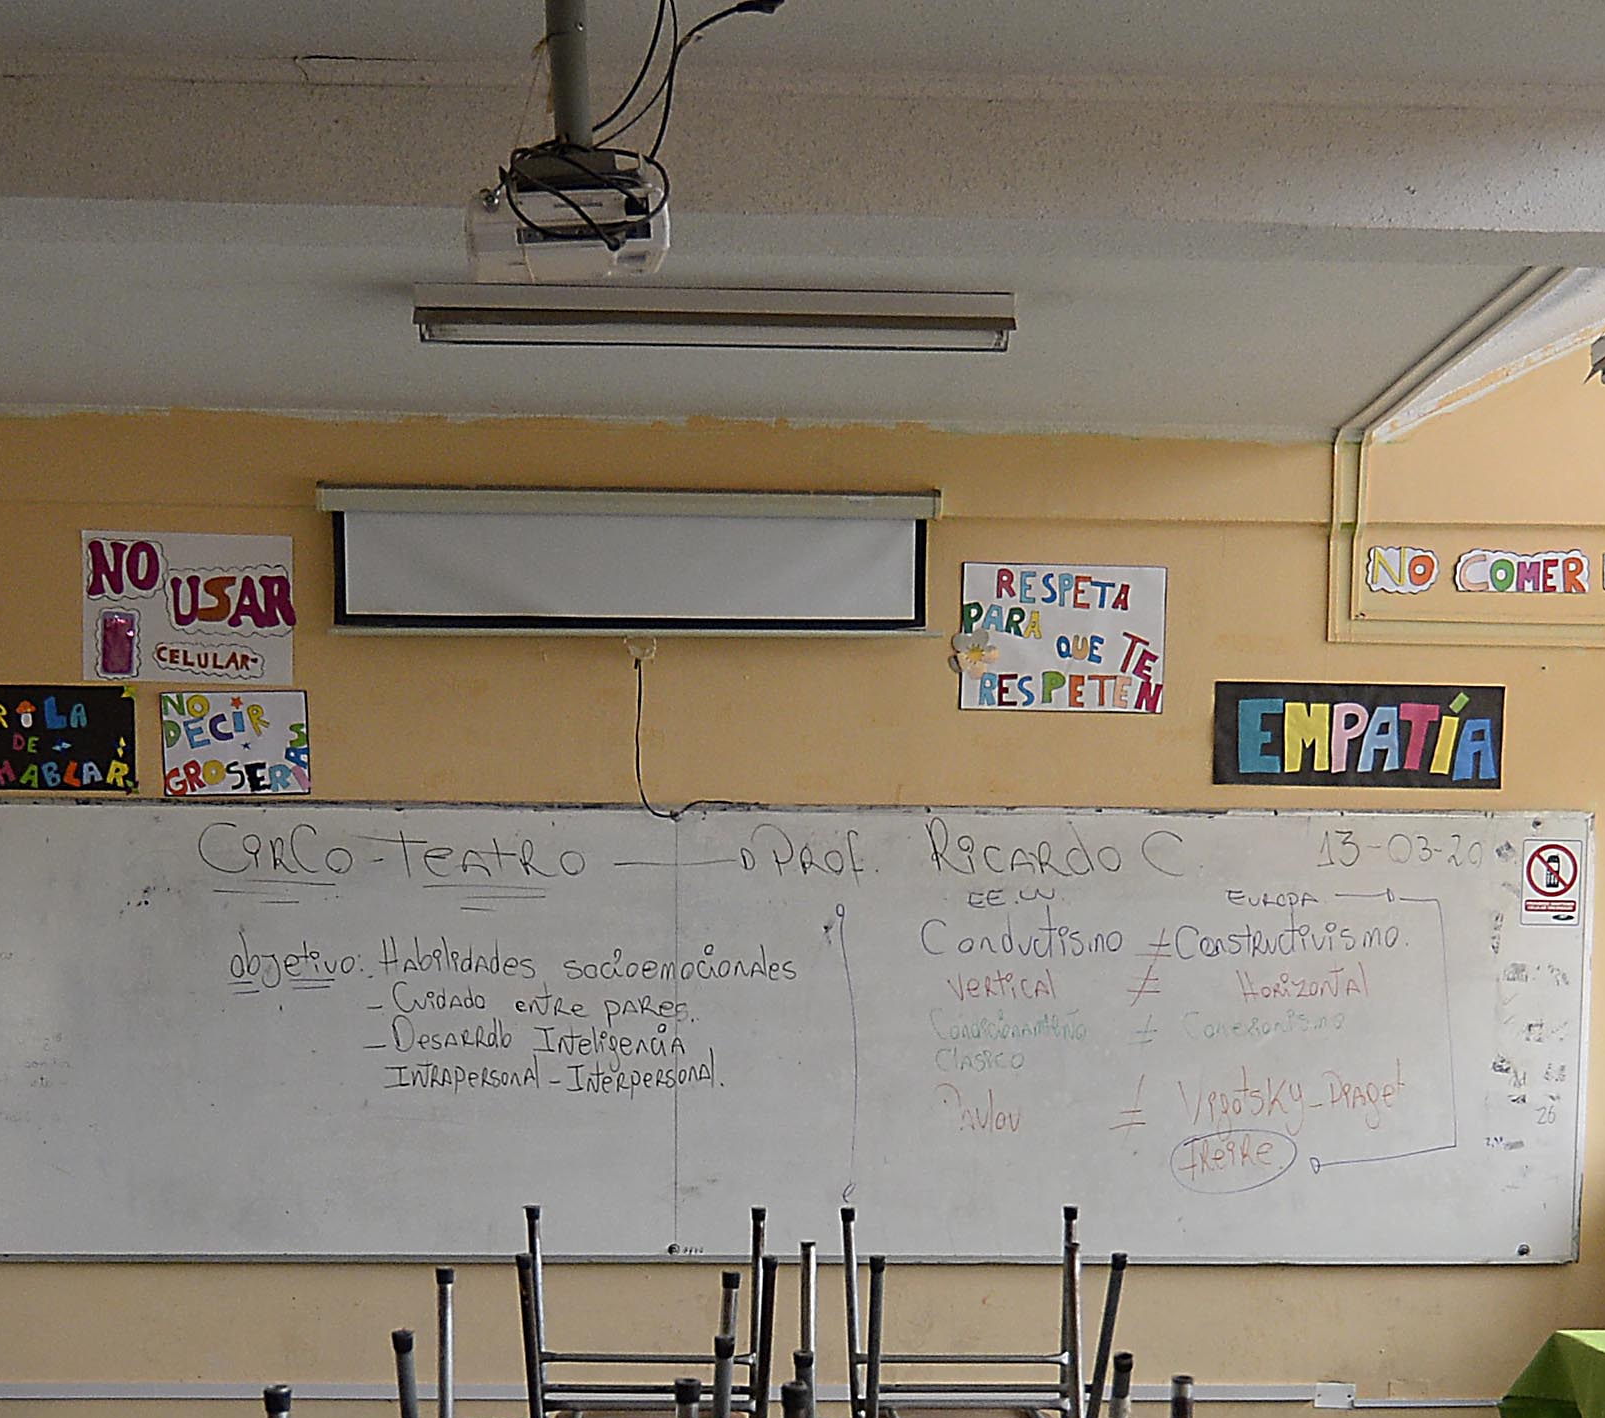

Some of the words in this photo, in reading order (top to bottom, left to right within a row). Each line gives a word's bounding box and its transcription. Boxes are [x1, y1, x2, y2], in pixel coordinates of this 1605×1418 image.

[87, 539, 160, 597] NO
[996, 568, 1131, 611] RESPETA
[1372, 547, 1436, 587] NO
[1460, 555, 1587, 592] COMER
[171, 575, 297, 628] USAR
[963, 601, 1042, 639] PARA
[155, 646, 252, 672] CELULAR
[1055, 634, 1105, 664] QUE
[1119, 631, 1160, 683] TE
[44, 696, 89, 730] LA
[162, 692, 210, 718] NO
[978, 670, 1164, 714] RESPETEN
[12, 732, 40, 753] DE
[164, 704, 271, 749] DECIR
[1237, 691, 1499, 781] EMPATÍA
